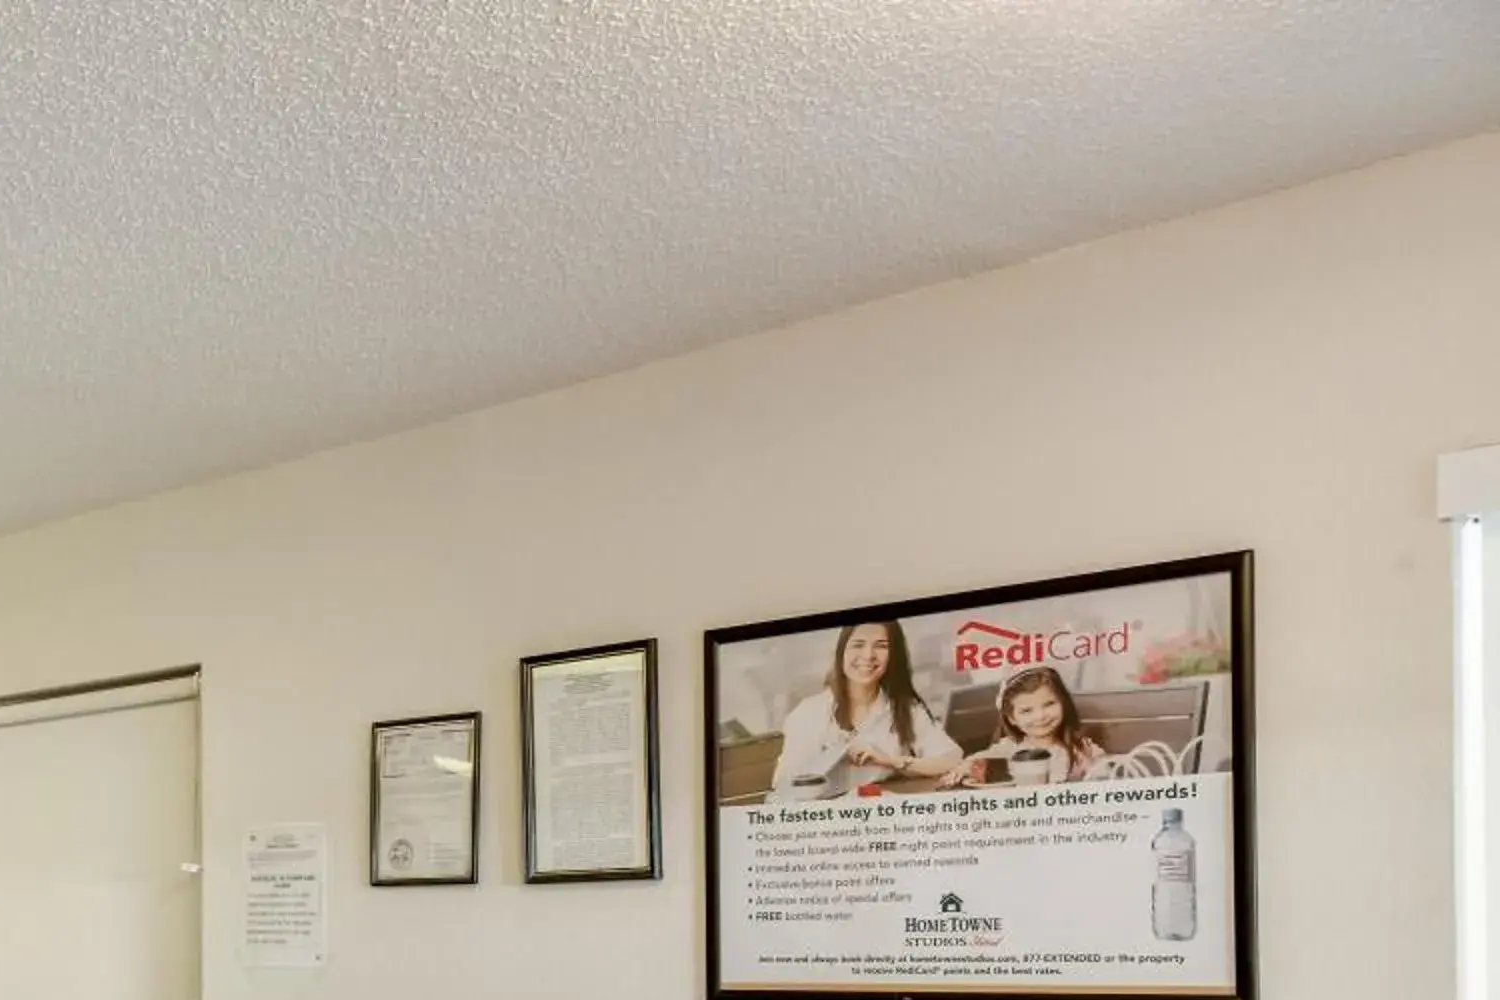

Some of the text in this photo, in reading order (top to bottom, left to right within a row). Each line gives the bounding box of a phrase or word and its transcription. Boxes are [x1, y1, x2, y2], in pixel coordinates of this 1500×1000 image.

[955, 621, 1129, 672] RediCard
[747, 783, 1198, 825] The fastest way to free nights and other rewards!
[917, 821, 953, 836] nights
[971, 818, 991, 832] gift
[1032, 815, 1053, 827] and
[1057, 811, 1138, 826] merchandise
[868, 841, 897, 852] FREE
[900, 840, 928, 853] night
[931, 838, 962, 851] point
[964, 834, 1036, 850] requirement
[1039, 833, 1049, 844] in
[1053, 832, 1074, 844] the
[1077, 830, 1128, 846] industry
[879, 858, 891, 869] to
[865, 875, 897, 887] offers
[755, 911, 783, 922] FREE
[904, 937, 967, 948] STUDIOS
[1104, 955, 1116, 963] or
[1119, 952, 1135, 963] the
[1138, 953, 1186, 966] property
